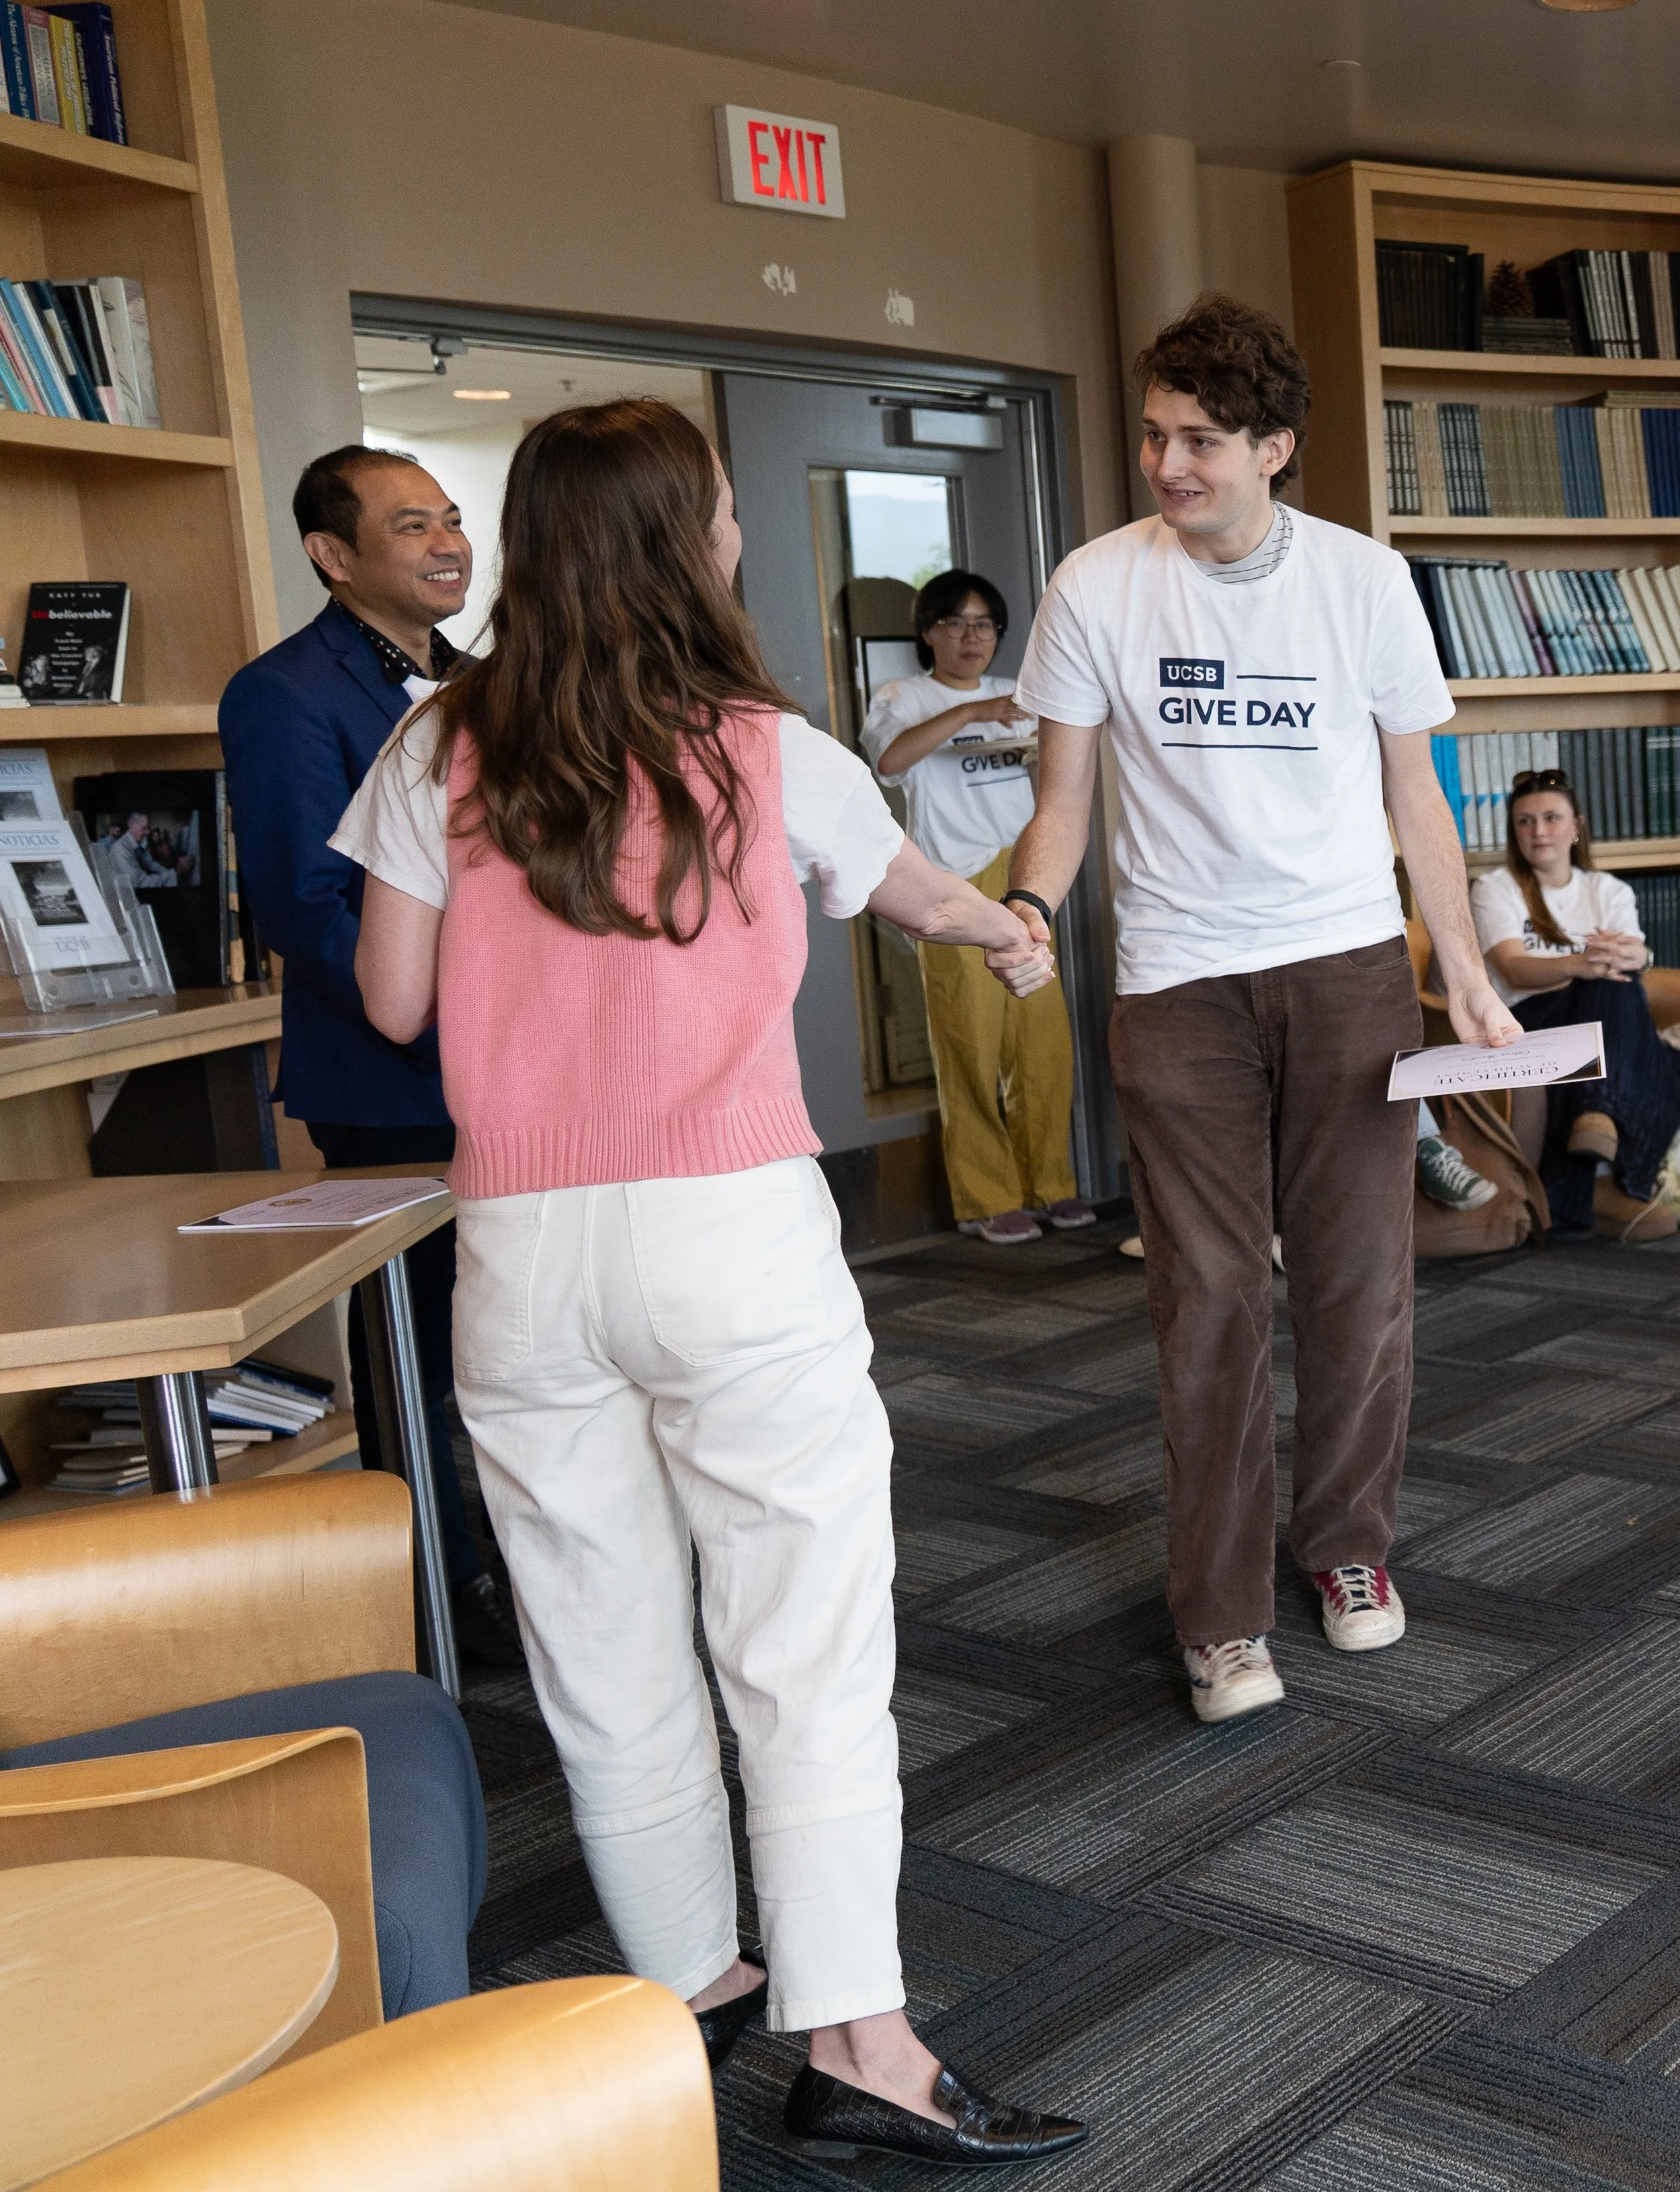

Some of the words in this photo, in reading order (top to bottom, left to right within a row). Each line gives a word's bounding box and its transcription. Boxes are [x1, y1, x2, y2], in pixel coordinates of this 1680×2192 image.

[14, 54, 24, 85] American
[104, 34, 114, 74] American
[110, 75, 120, 112] Political
[114, 112, 124, 145] Reform
[747, 120, 827, 205] EXIT
[1167, 665, 1217, 682] UCSB
[1159, 697, 1236, 726] GIVE
[1247, 700, 1316, 728] DAY
[962, 754, 1000, 772] GIVE
[1433, 1066, 1558, 1086] CERTIFICATE
[1436, 1063, 1533, 1078] ACHIEVEMENT
